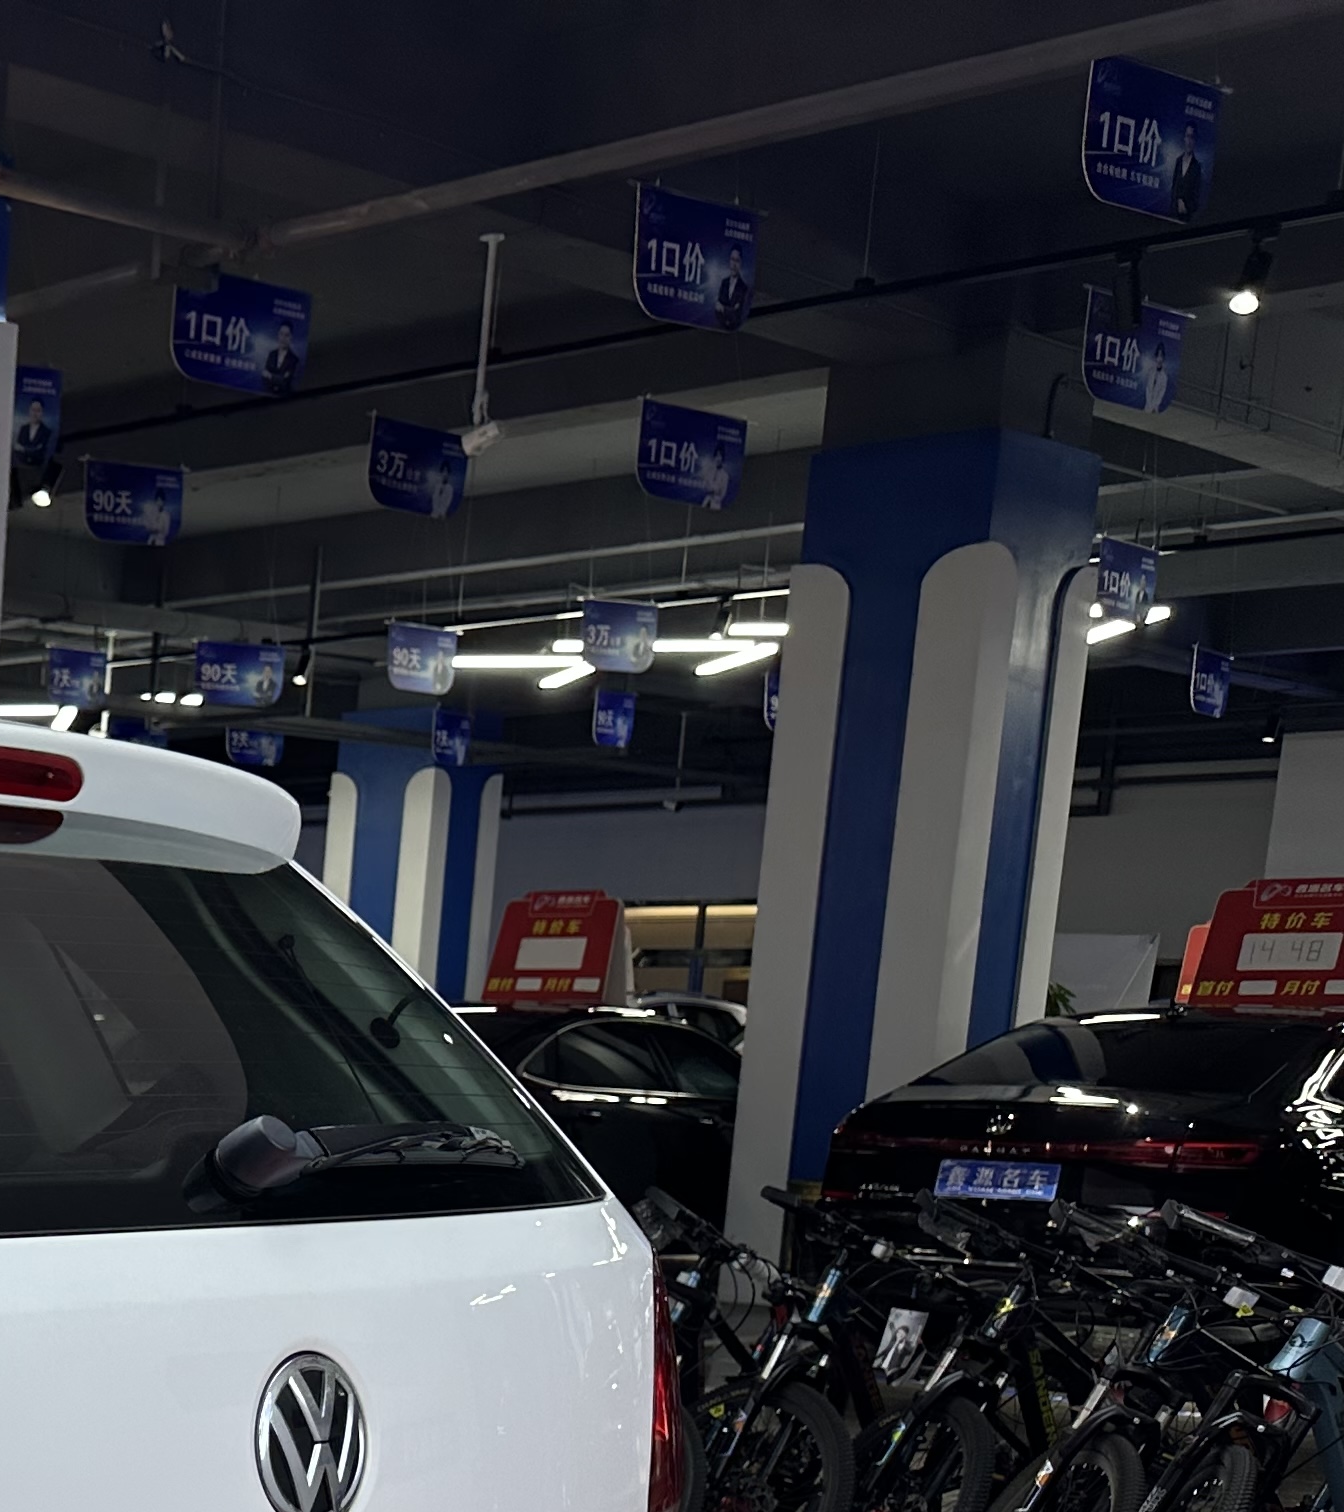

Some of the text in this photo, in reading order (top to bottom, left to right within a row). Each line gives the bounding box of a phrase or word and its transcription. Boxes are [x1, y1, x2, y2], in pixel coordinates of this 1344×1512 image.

[1099, 111, 1162, 168] 1口价
[647, 238, 705, 285] 1口价
[185, 310, 251, 354] 1口价
[1094, 333, 1141, 374] 1口价
[647, 438, 699, 473] 1口价
[92, 489, 133, 515] 90天
[1102, 569, 1131, 598] 1口价
[200, 662, 238, 684] 90天
[532, 918, 582, 936] 特价车
[1260, 911, 1334, 930] 特价车
[1196, 979, 1235, 996] 首付
[1280, 979, 1320, 996] 月付
